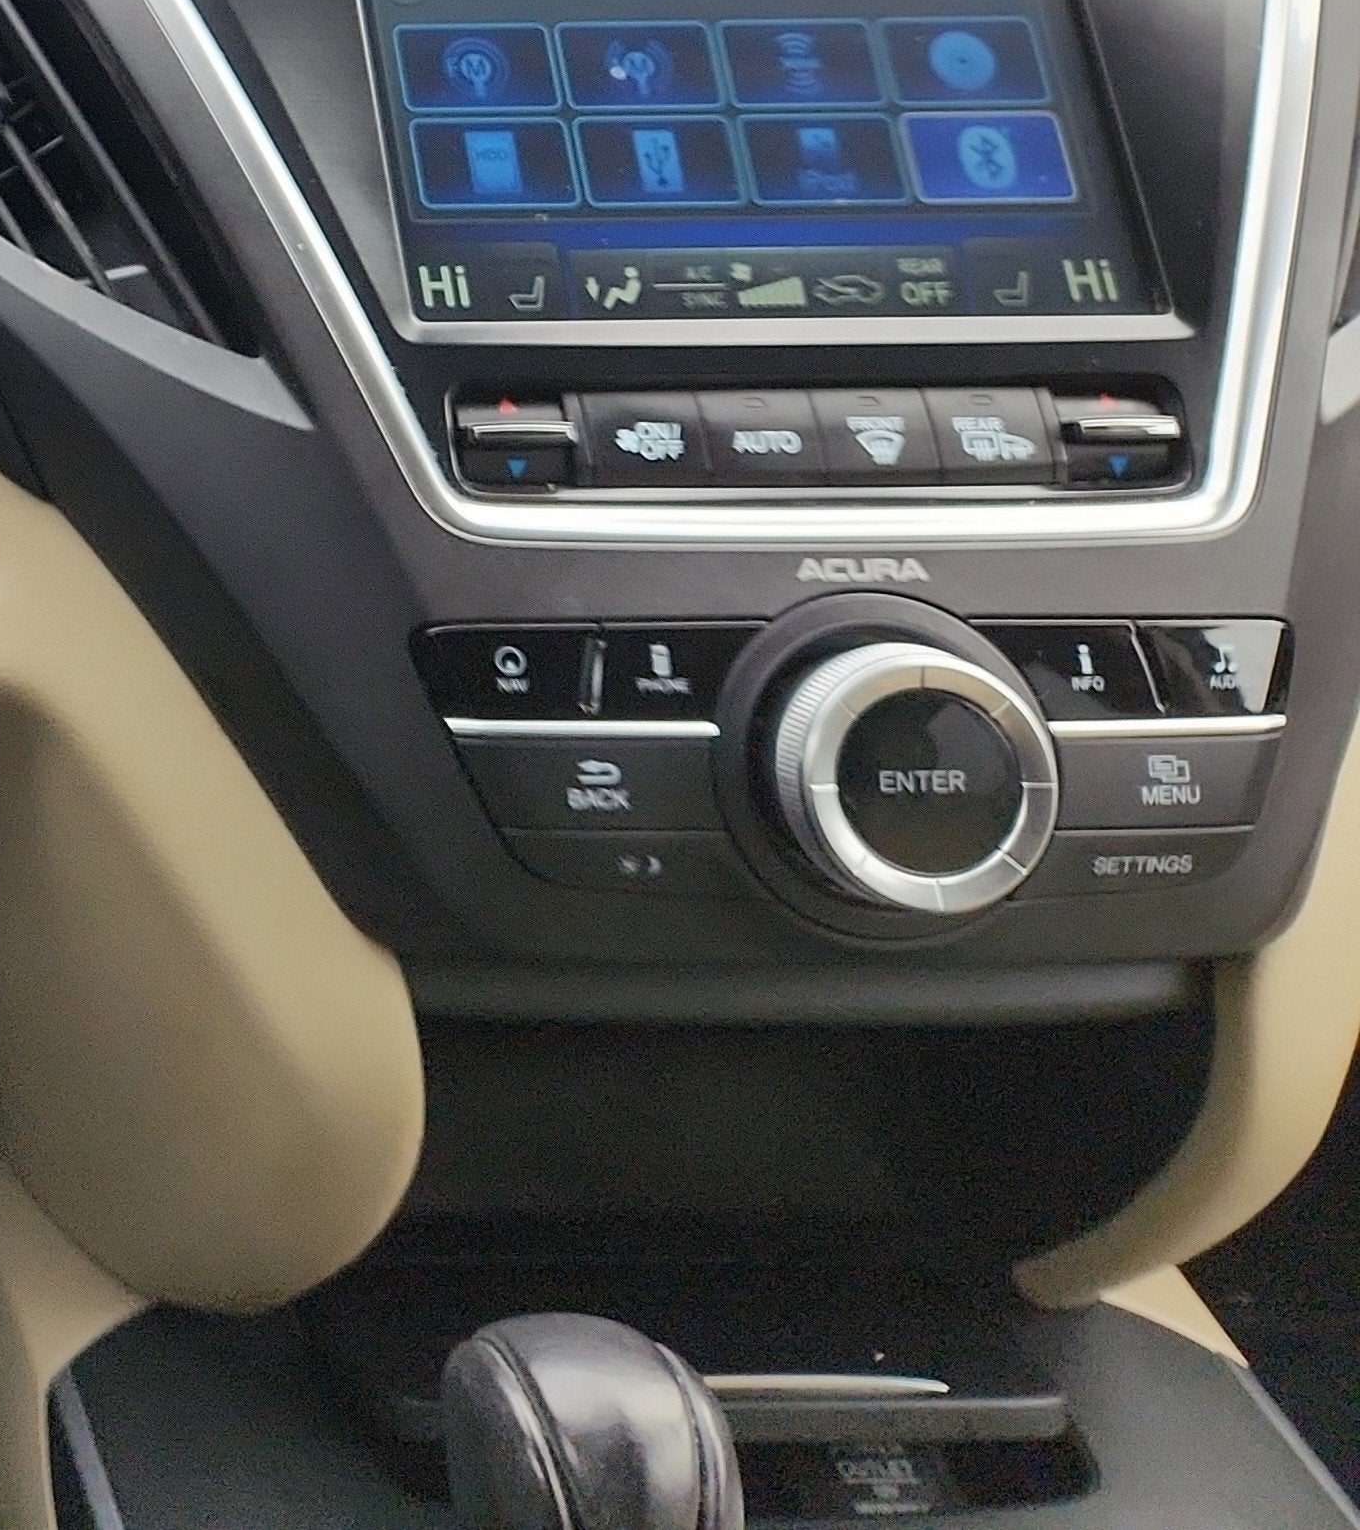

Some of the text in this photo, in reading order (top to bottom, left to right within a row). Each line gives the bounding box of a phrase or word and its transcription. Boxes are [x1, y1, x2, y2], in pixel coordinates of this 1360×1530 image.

[418, 266, 471, 309] Hi
[900, 280, 951, 306] OFF
[1062, 260, 1118, 304] Hi
[846, 416, 905, 433] FRONT
[951, 416, 1005, 433] REAR
[642, 439, 685, 461] OFF
[733, 429, 803, 455] AUTO
[796, 557, 931, 582] ACURA
[878, 768, 966, 795] ENTER
[566, 786, 631, 811] BACK
[1141, 785, 1201, 806] MENU
[1093, 854, 1193, 876] SETTINGS
